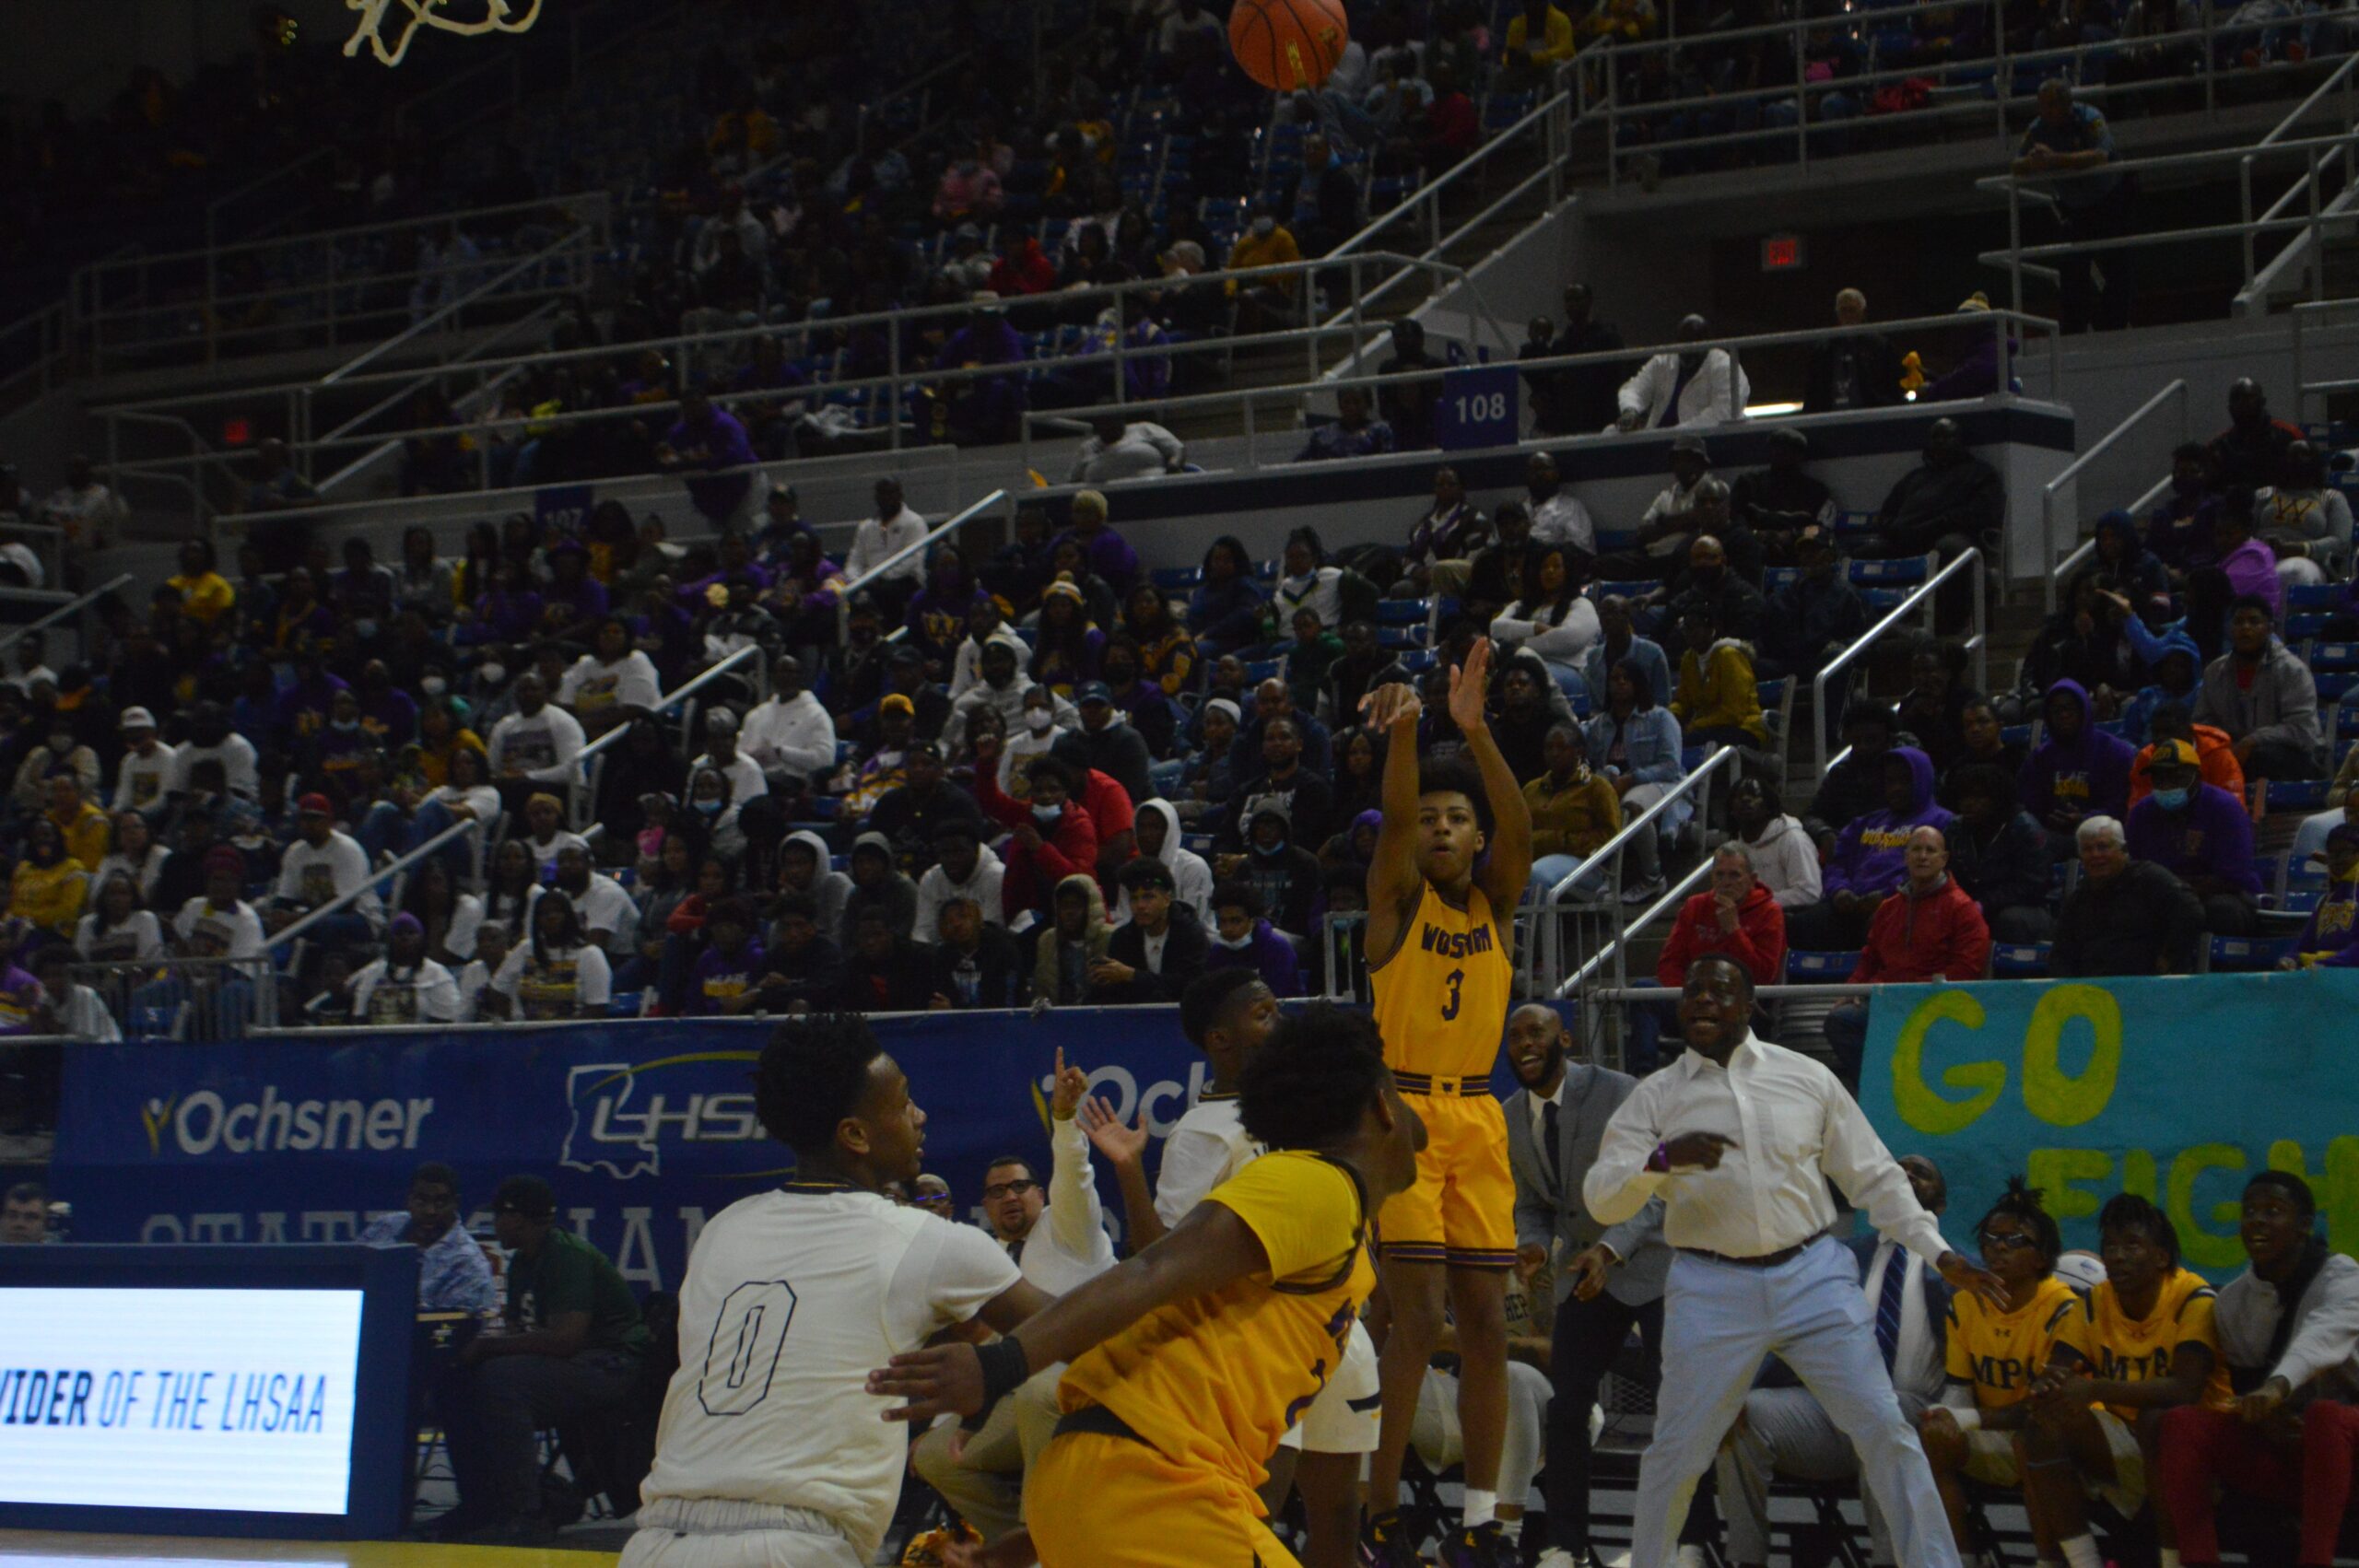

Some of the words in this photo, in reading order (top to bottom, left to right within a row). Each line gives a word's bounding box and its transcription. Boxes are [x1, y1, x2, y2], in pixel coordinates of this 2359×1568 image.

[1455, 392, 1507, 424] 108
[1441, 968, 1465, 1022] 3
[1892, 983, 2123, 1135] GO
[174, 1084, 434, 1155] Ochsner
[591, 1093, 768, 1141] LHS
[699, 1280, 797, 1416] 0
[99, 1370, 144, 1428] OF
[152, 1371, 215, 1430] THE
[221, 1373, 326, 1433] LHSAA
